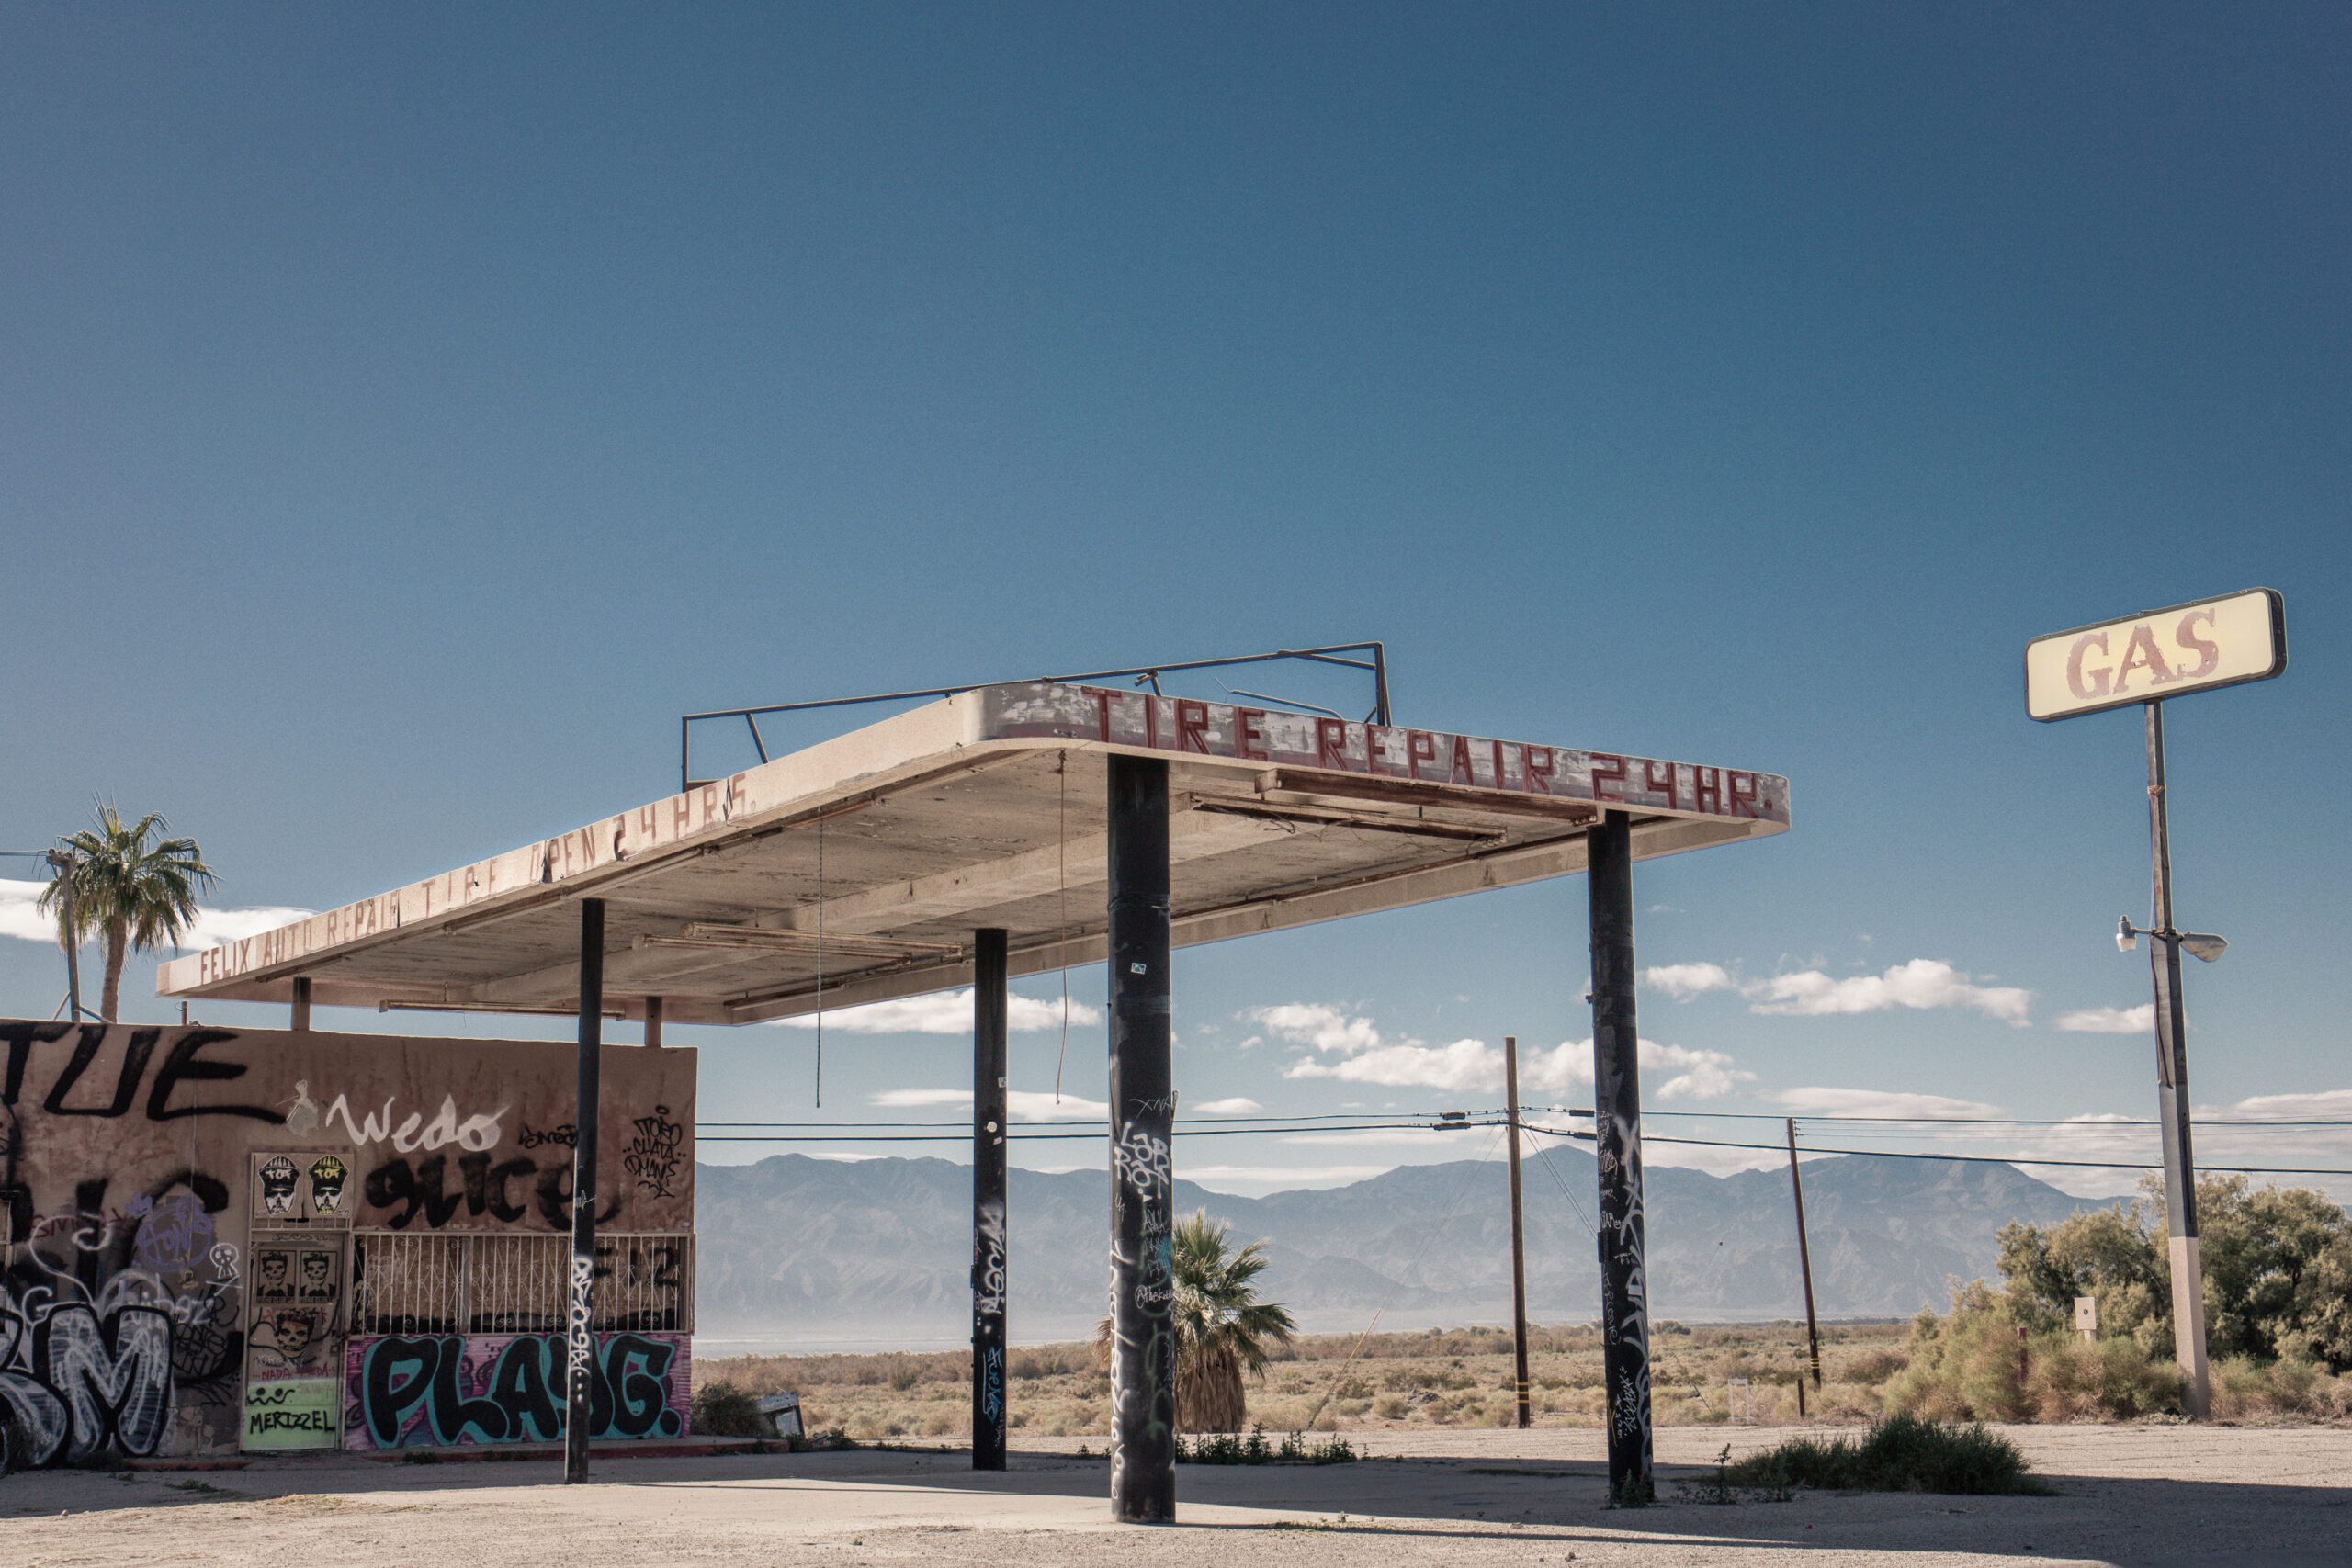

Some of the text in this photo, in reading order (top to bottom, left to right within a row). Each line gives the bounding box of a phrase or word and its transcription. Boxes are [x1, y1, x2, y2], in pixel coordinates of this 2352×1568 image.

[2067, 608, 2219, 700] GAS
[1081, 686, 1269, 761] TIRE
[1314, 717, 1554, 795] REPAIR
[200, 937, 252, 986] FELIX
[263, 919, 313, 966] AUTO
[326, 888, 400, 945] REPAIR
[529, 826, 597, 884] OPEN
